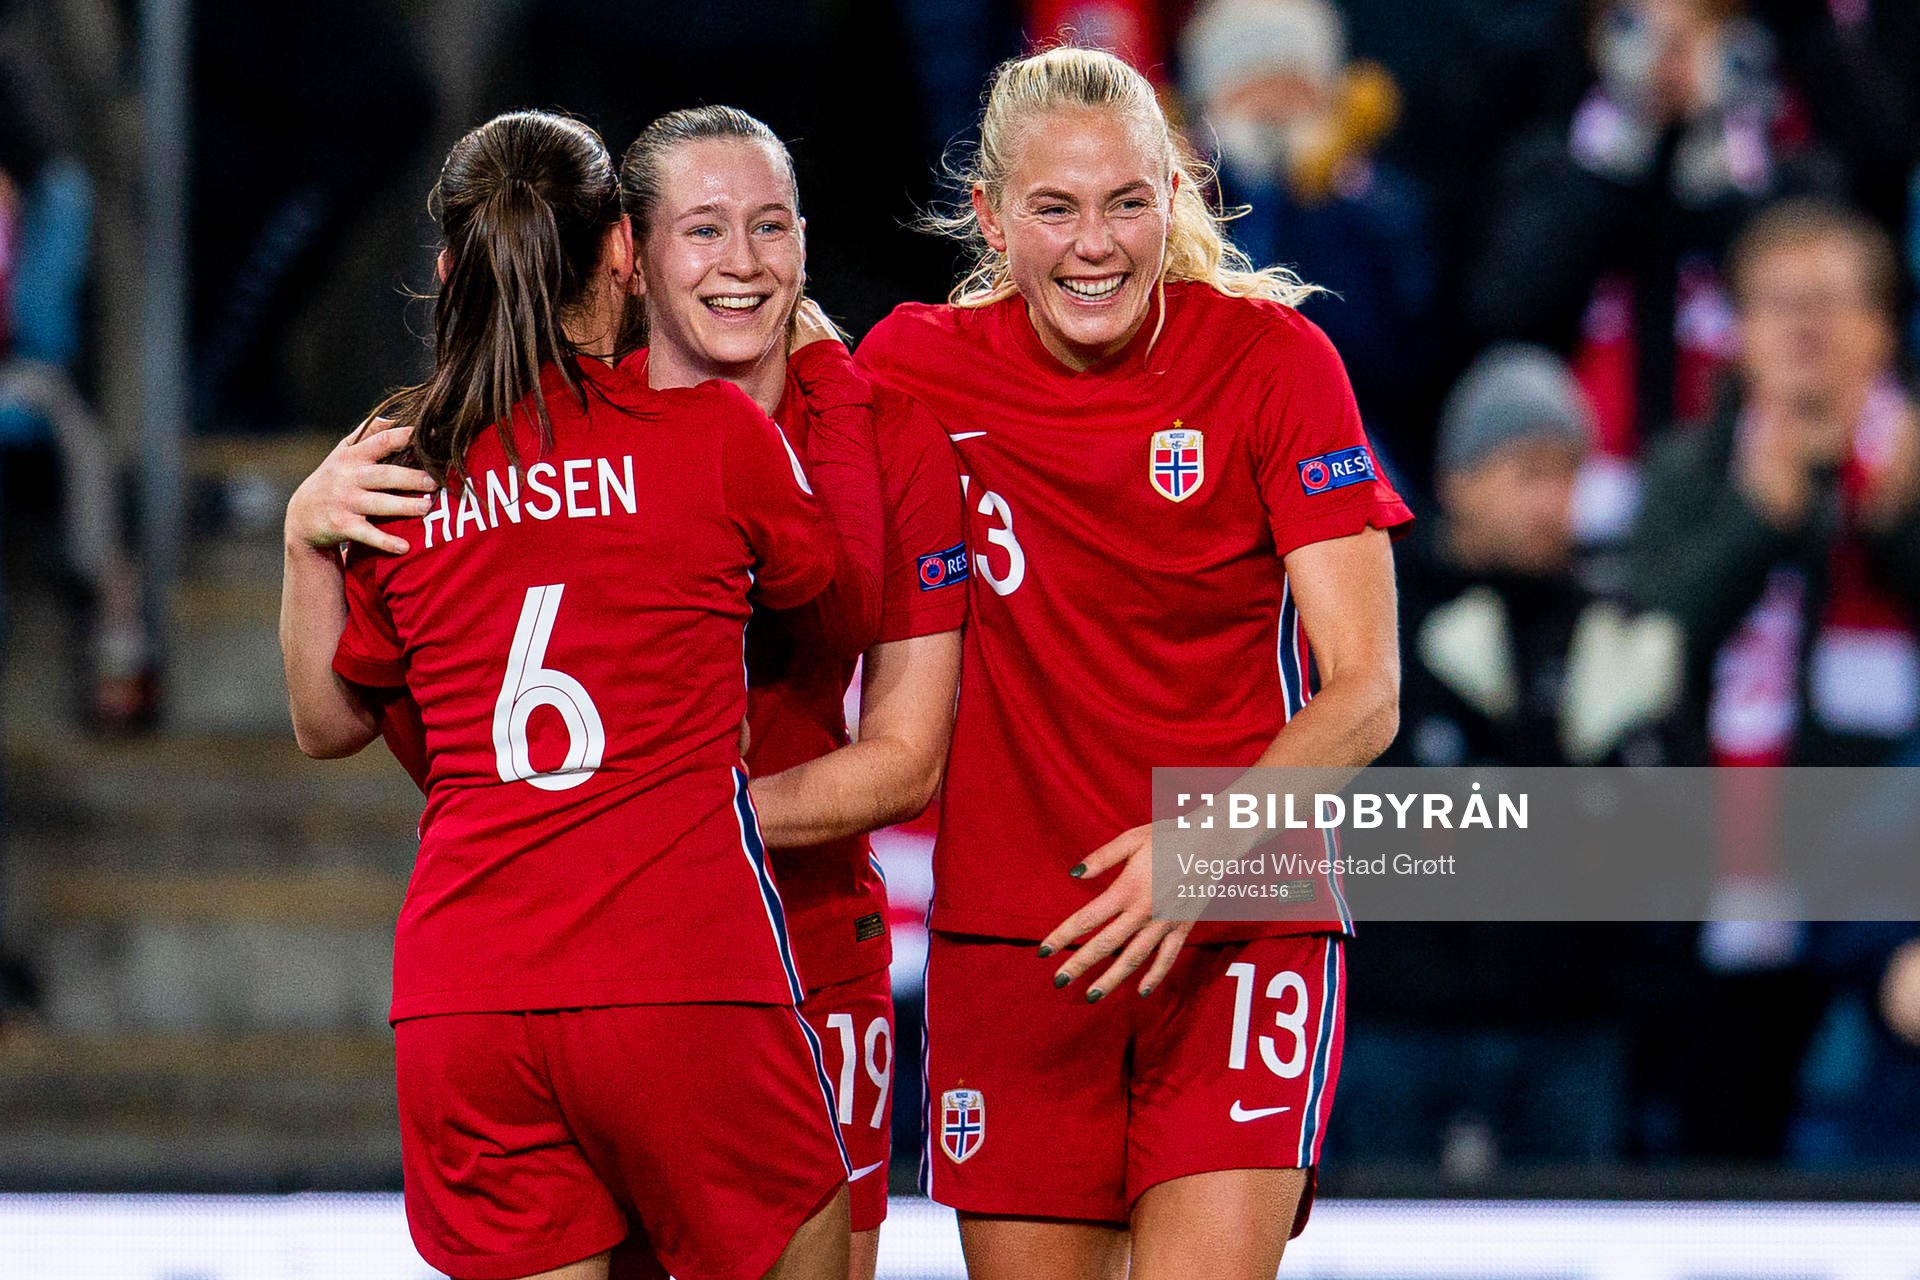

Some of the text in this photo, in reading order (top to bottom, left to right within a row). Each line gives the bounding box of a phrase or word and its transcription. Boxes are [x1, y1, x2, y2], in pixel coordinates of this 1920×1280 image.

[423, 455, 637, 549] HANSEN
[960, 476, 1026, 597] 3
[492, 583, 606, 792] 6
[825, 1013, 892, 1130] 19
[1225, 962, 1309, 1079] 13
